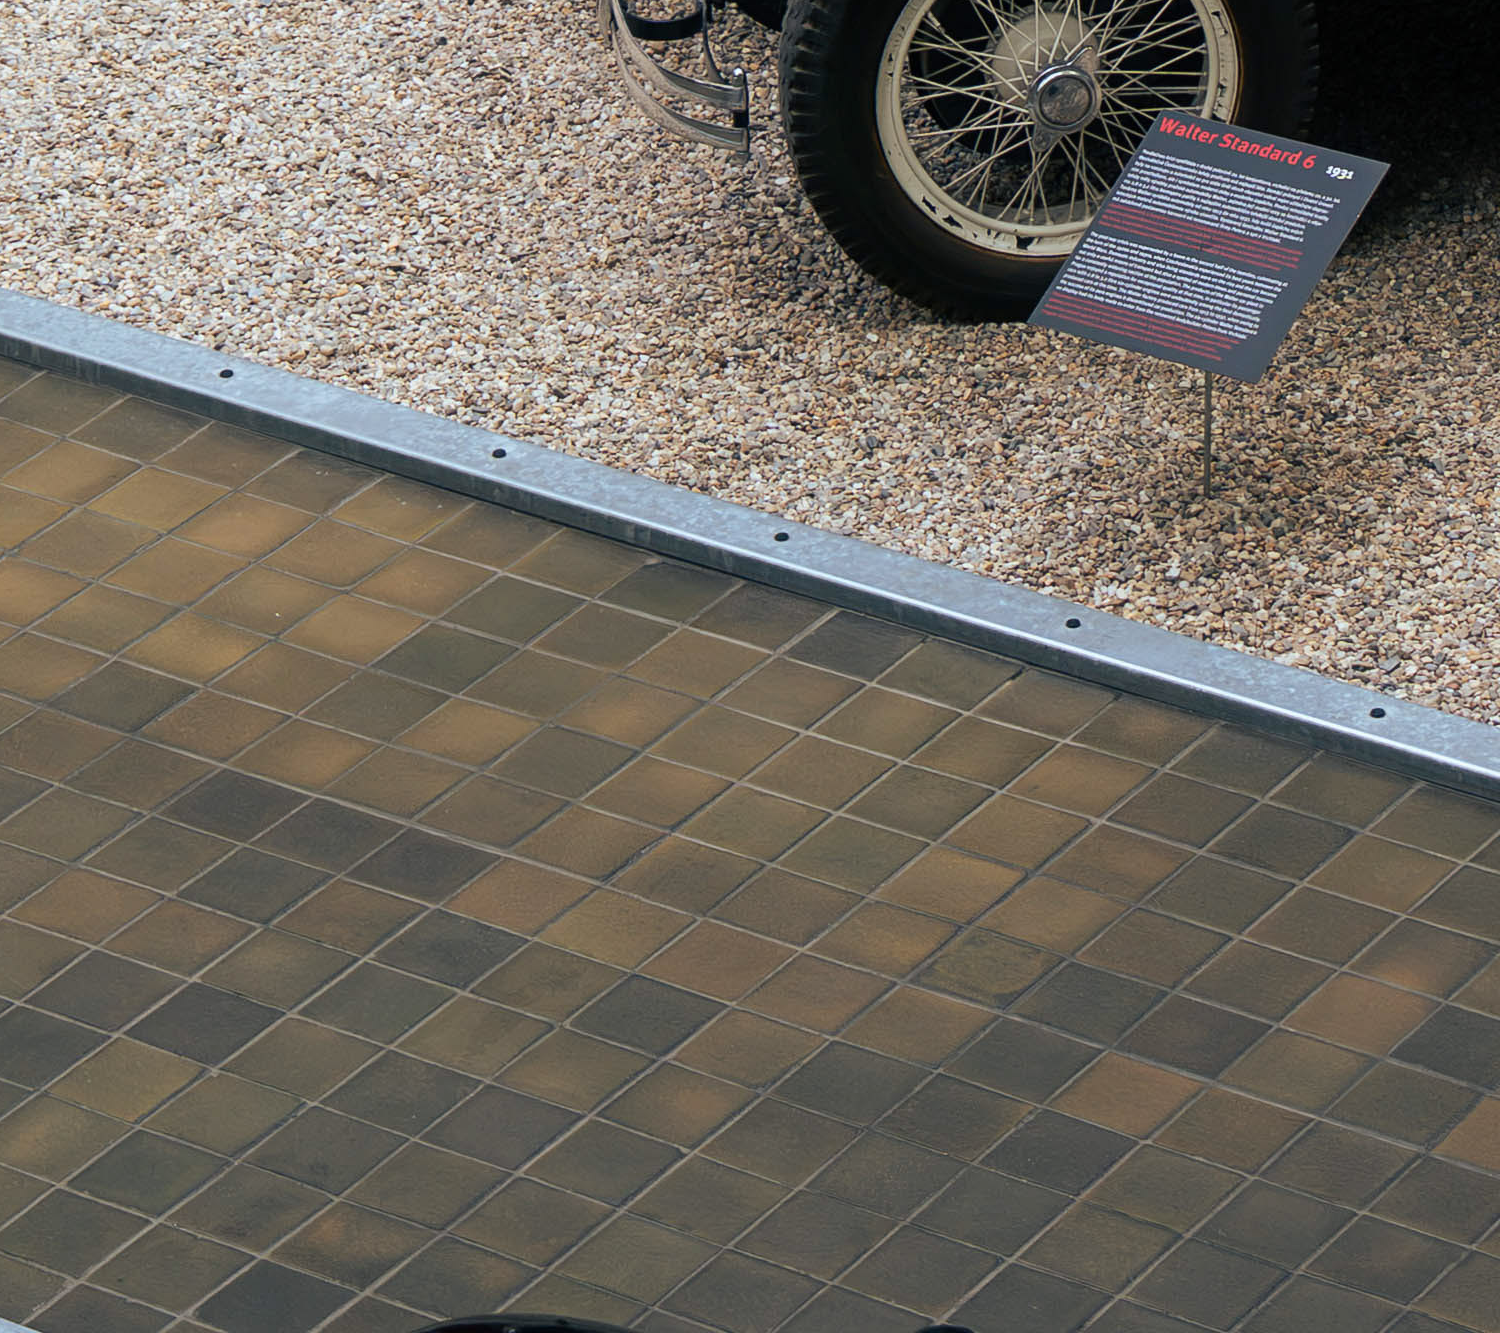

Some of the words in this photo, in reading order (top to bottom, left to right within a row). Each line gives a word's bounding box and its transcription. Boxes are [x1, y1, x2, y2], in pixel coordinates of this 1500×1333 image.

[1158, 116, 1218, 146] Walter
[1218, 132, 1304, 167] Standard
[1303, 153, 1317, 170] 6
[1325, 164, 1355, 181] 1931
